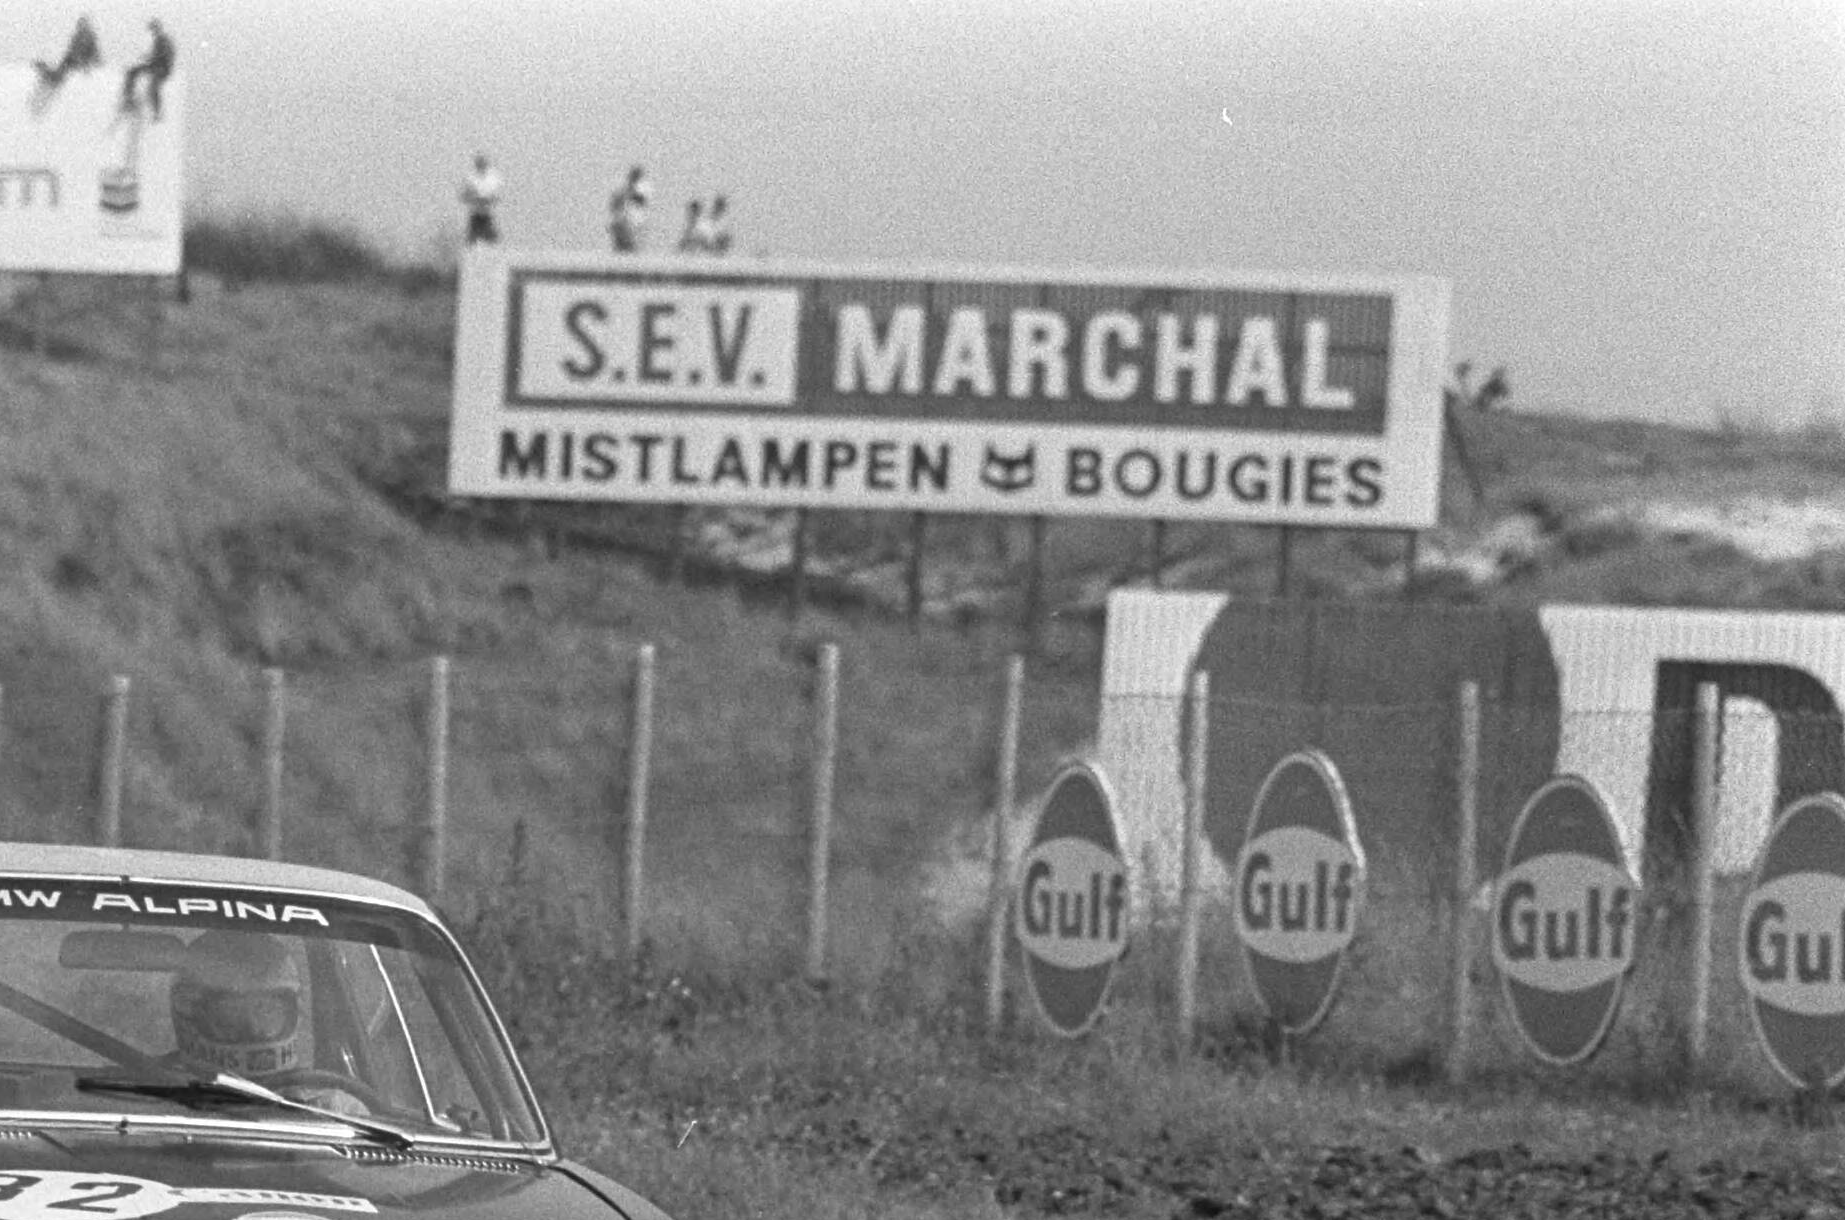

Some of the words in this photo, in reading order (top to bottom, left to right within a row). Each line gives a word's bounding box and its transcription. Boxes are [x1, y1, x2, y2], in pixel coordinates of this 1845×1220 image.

[560, 299, 766, 387] S.E.V.
[836, 303, 1355, 408] MARCHAL
[497, 428, 951, 493] MISTLAMPEN
[1064, 446, 1385, 509] BOUGIES
[92, 893, 330, 927] ALPINA
[1021, 862, 1127, 941] Gulf
[1240, 851, 1355, 933] Gulf
[1497, 879, 1631, 962] Gulf
[1744, 899, 1845, 985] Gu
